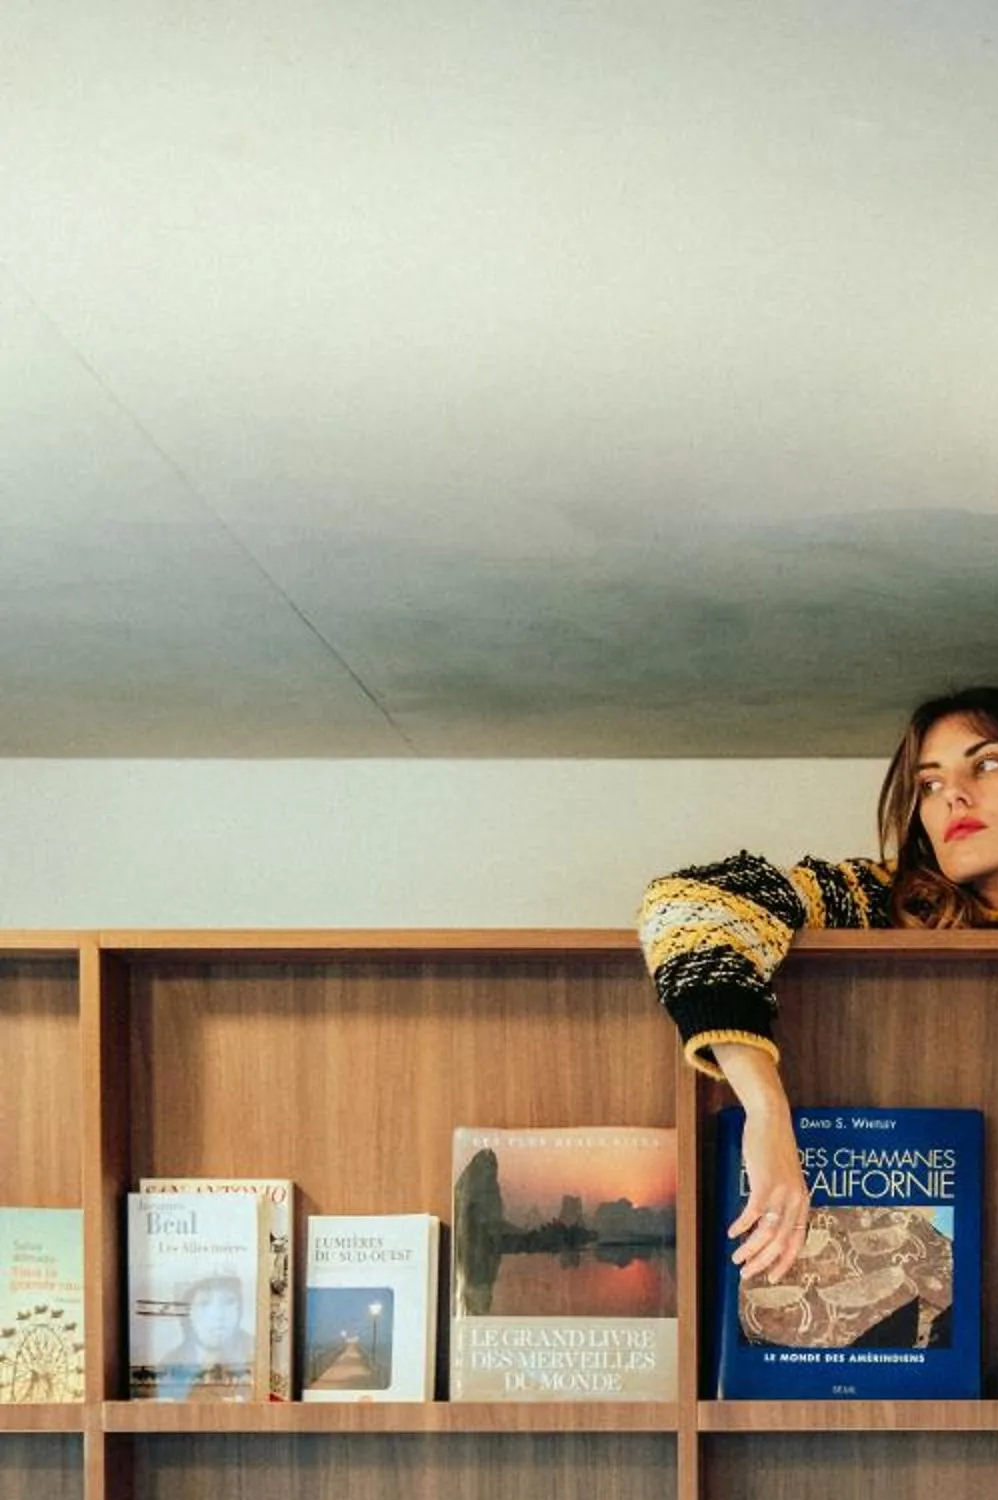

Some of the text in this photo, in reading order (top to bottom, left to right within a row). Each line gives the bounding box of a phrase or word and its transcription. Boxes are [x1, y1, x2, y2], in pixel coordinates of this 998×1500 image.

[833, 1148, 956, 1169] CHAMANES
[471, 1329, 656, 1348] LE GRAND LIVRE
[471, 1350, 657, 1370] DES MERVEILLES
[763, 1353, 776, 1364] LE
[779, 1353, 821, 1364] MONDE
[825, 1353, 845, 1364] DES
[505, 1371, 622, 1392] DU MONDE
